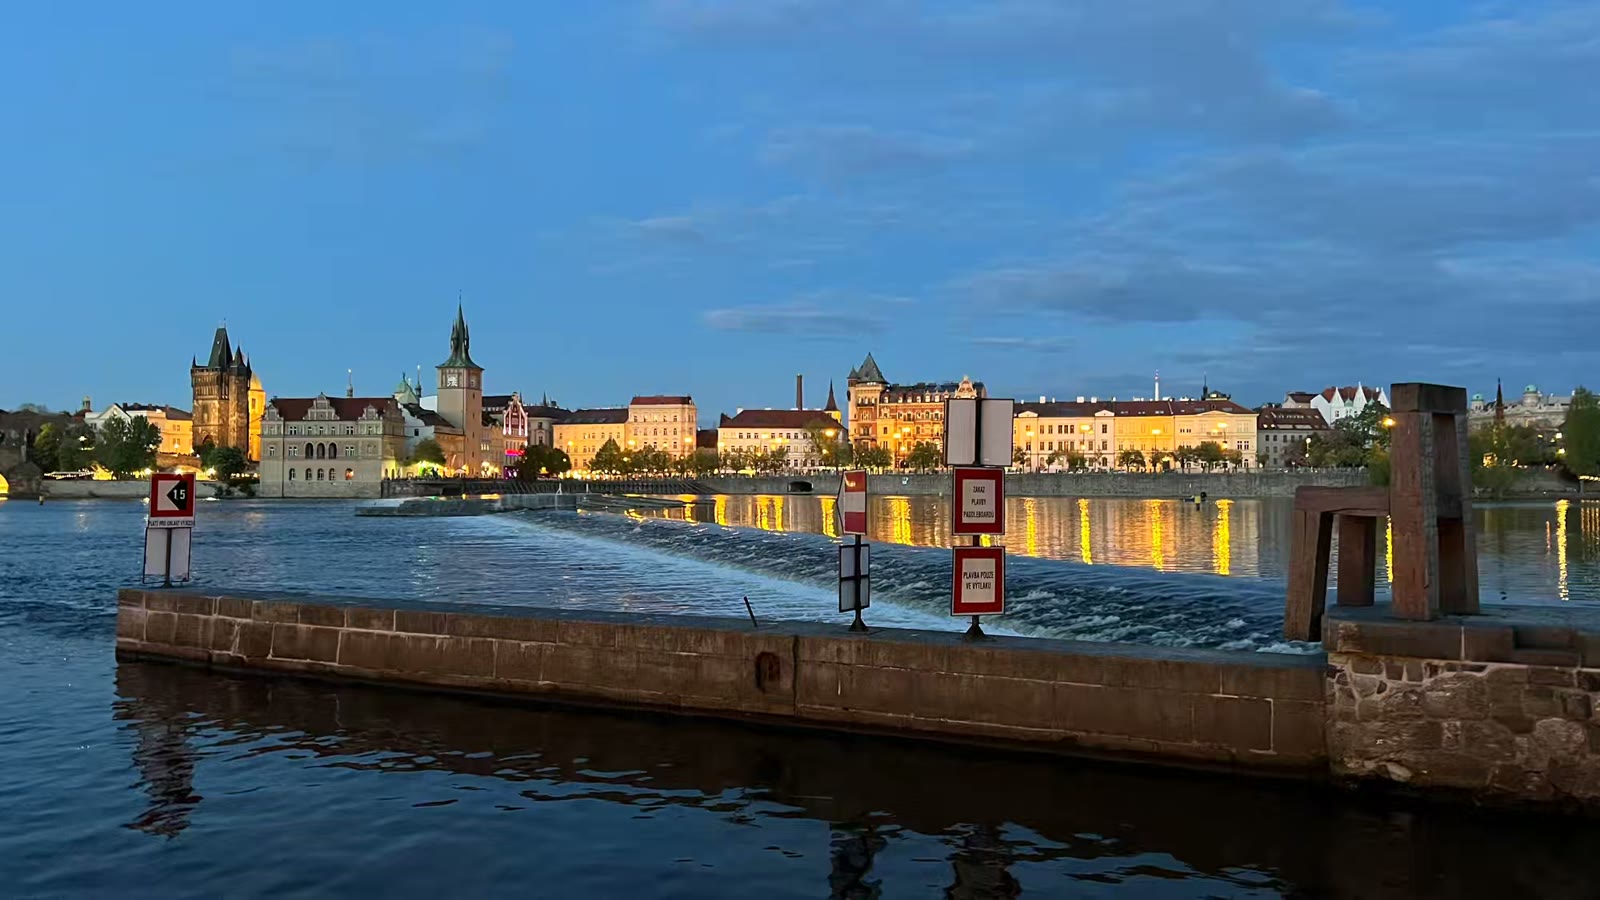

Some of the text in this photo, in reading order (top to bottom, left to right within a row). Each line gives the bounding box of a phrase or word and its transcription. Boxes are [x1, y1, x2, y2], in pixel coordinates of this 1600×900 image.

[173, 489, 186, 500] 15
[963, 571, 994, 579] PLAVBA POUZE
